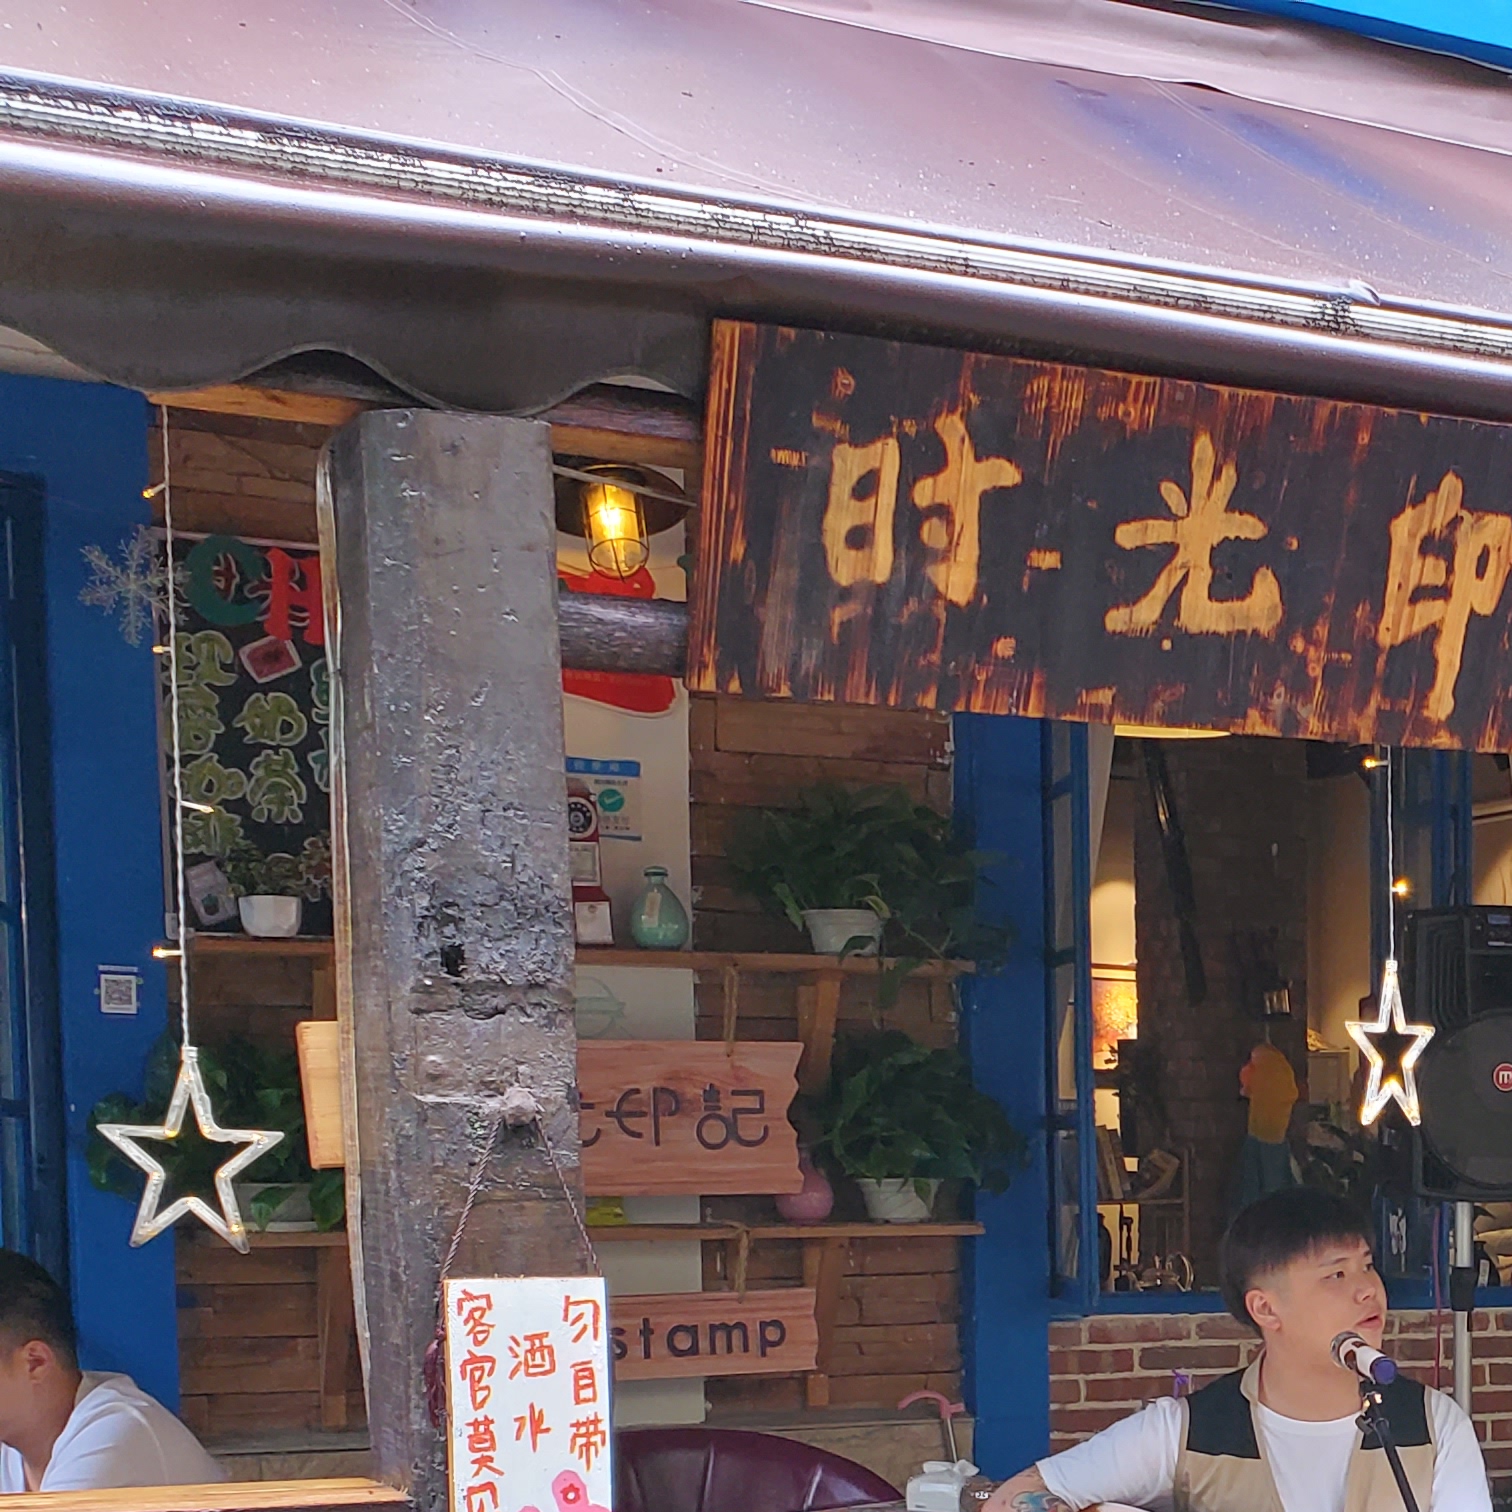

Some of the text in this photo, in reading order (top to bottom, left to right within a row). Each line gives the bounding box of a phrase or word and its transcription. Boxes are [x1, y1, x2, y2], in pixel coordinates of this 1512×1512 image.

[232, 691, 308, 824] 奶茶
[507, 1330, 556, 1453] 酒水
[562, 1294, 606, 1473] 勿自带
[610, 1317, 787, 1361] stamp
